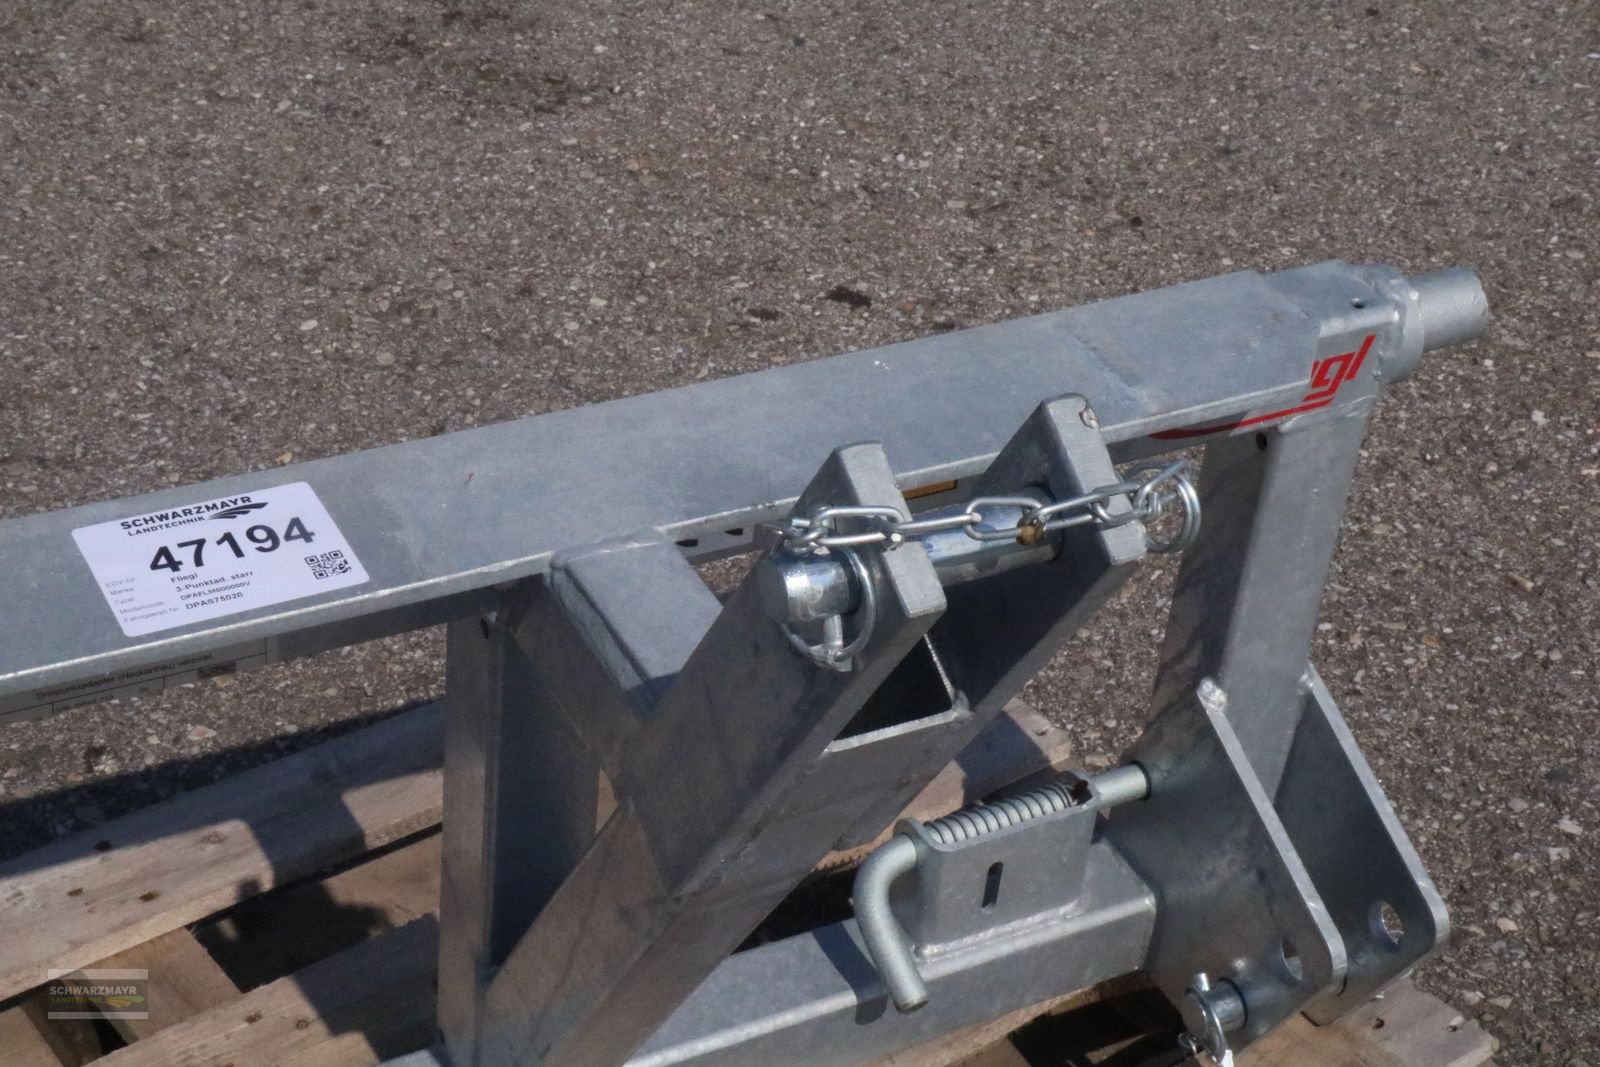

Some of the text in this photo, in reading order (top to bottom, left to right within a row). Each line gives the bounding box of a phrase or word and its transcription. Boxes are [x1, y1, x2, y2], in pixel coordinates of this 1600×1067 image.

[1302, 334, 1376, 402] gl
[120, 496, 253, 530] SCHWARZMAYR
[127, 515, 206, 537] LANDTECHNIK
[149, 516, 316, 573] 47194
[170, 572, 199, 583] Fliegl
[230, 570, 254, 581] starr
[185, 592, 244, 611] DPAS75020
